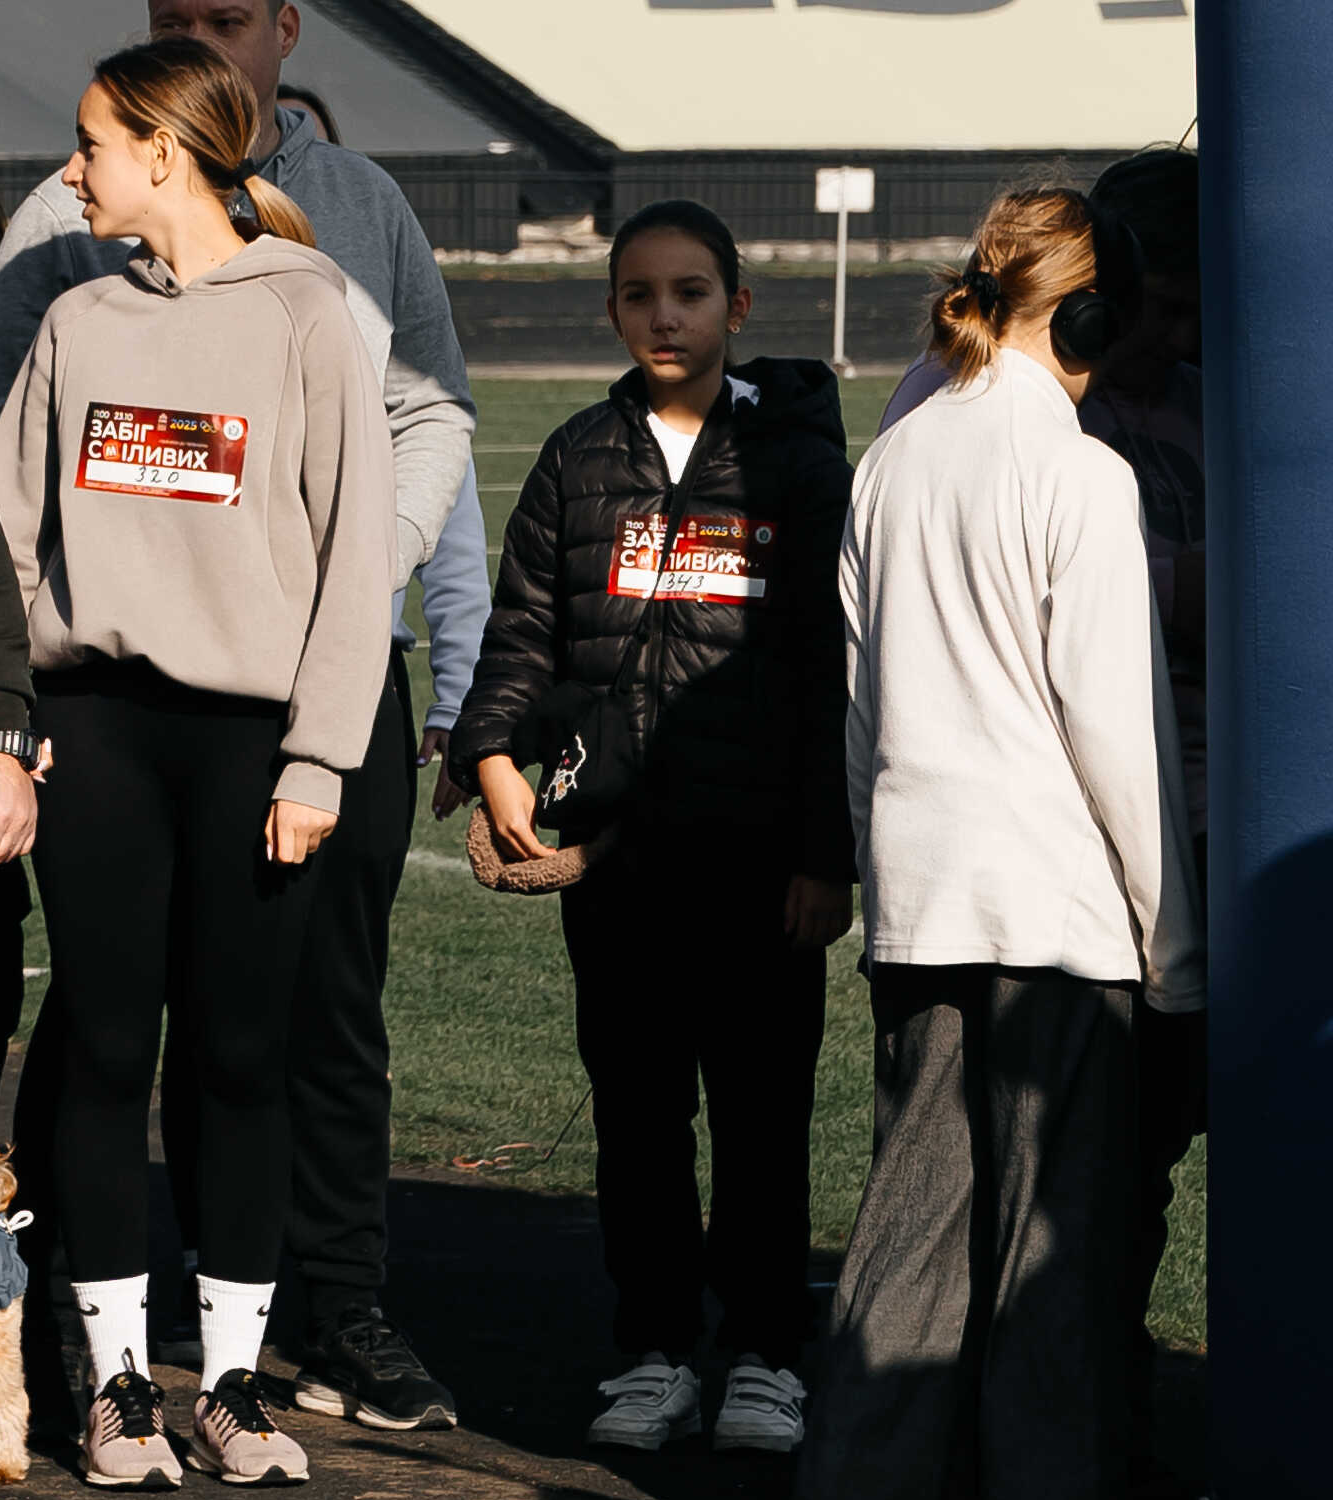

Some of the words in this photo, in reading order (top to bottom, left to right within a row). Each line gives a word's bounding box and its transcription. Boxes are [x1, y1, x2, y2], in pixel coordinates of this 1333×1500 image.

[90, 419, 155, 443] ЗАБІГ
[169, 418, 198, 432] 2025
[135, 467, 180, 484] 320
[699, 525, 729, 537] 2025
[622, 529, 685, 551] ЗАБГ
